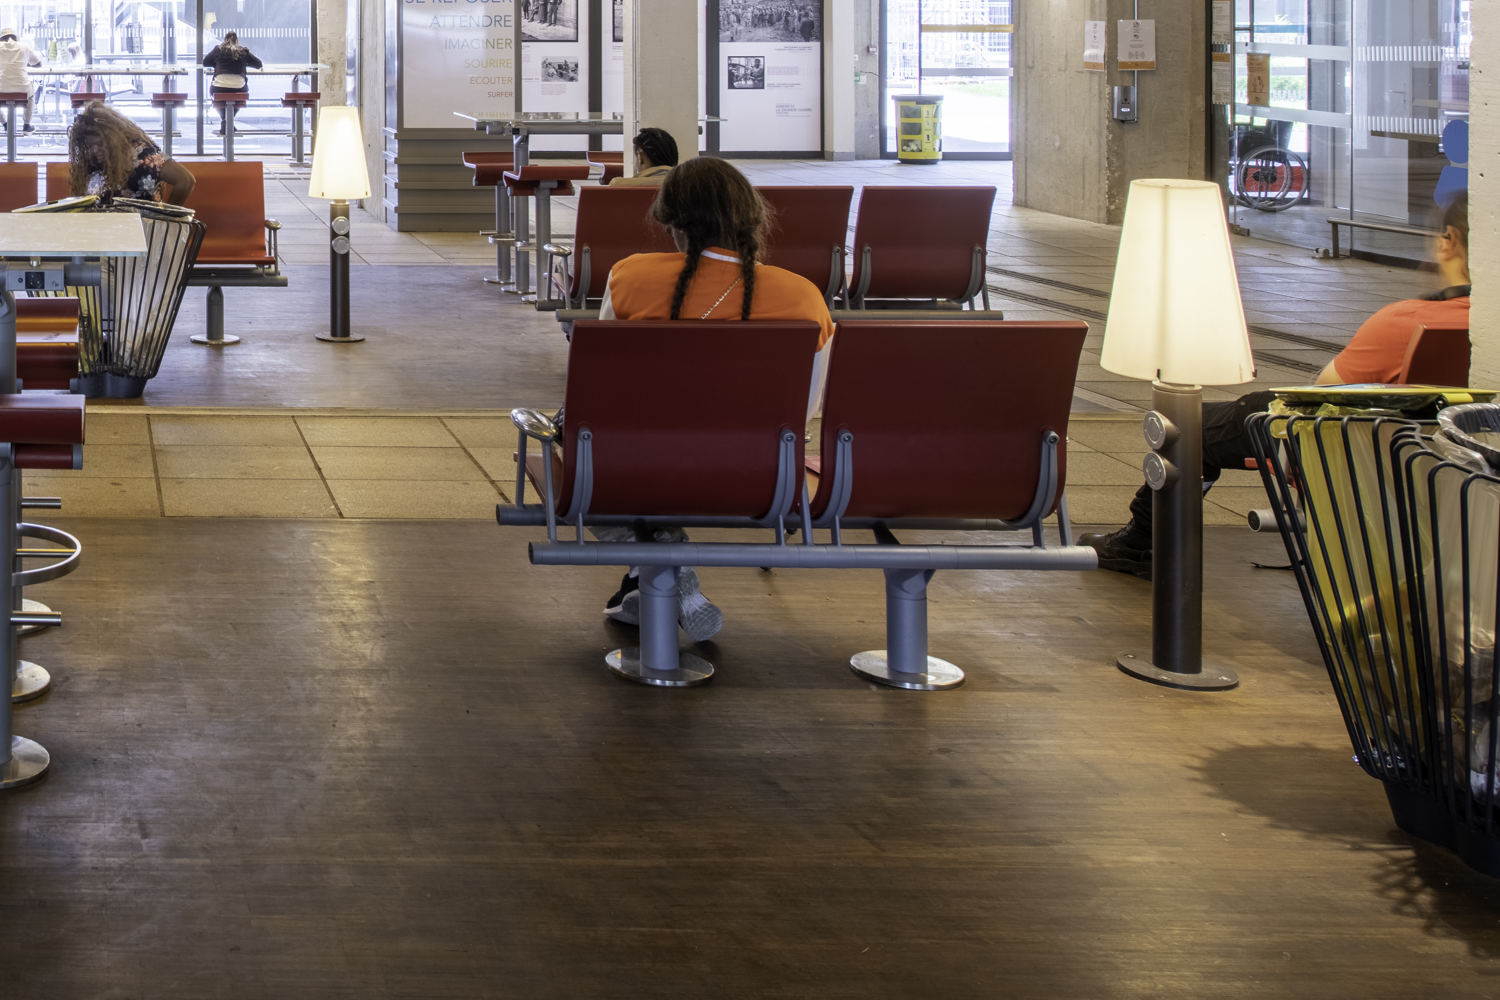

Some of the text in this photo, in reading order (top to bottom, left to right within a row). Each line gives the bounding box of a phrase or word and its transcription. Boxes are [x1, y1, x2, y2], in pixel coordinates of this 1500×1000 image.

[430, 15, 512, 28] ATTENDRE
[444, 38, 512, 50] IMAGINER
[464, 59, 512, 69] SOURIRE
